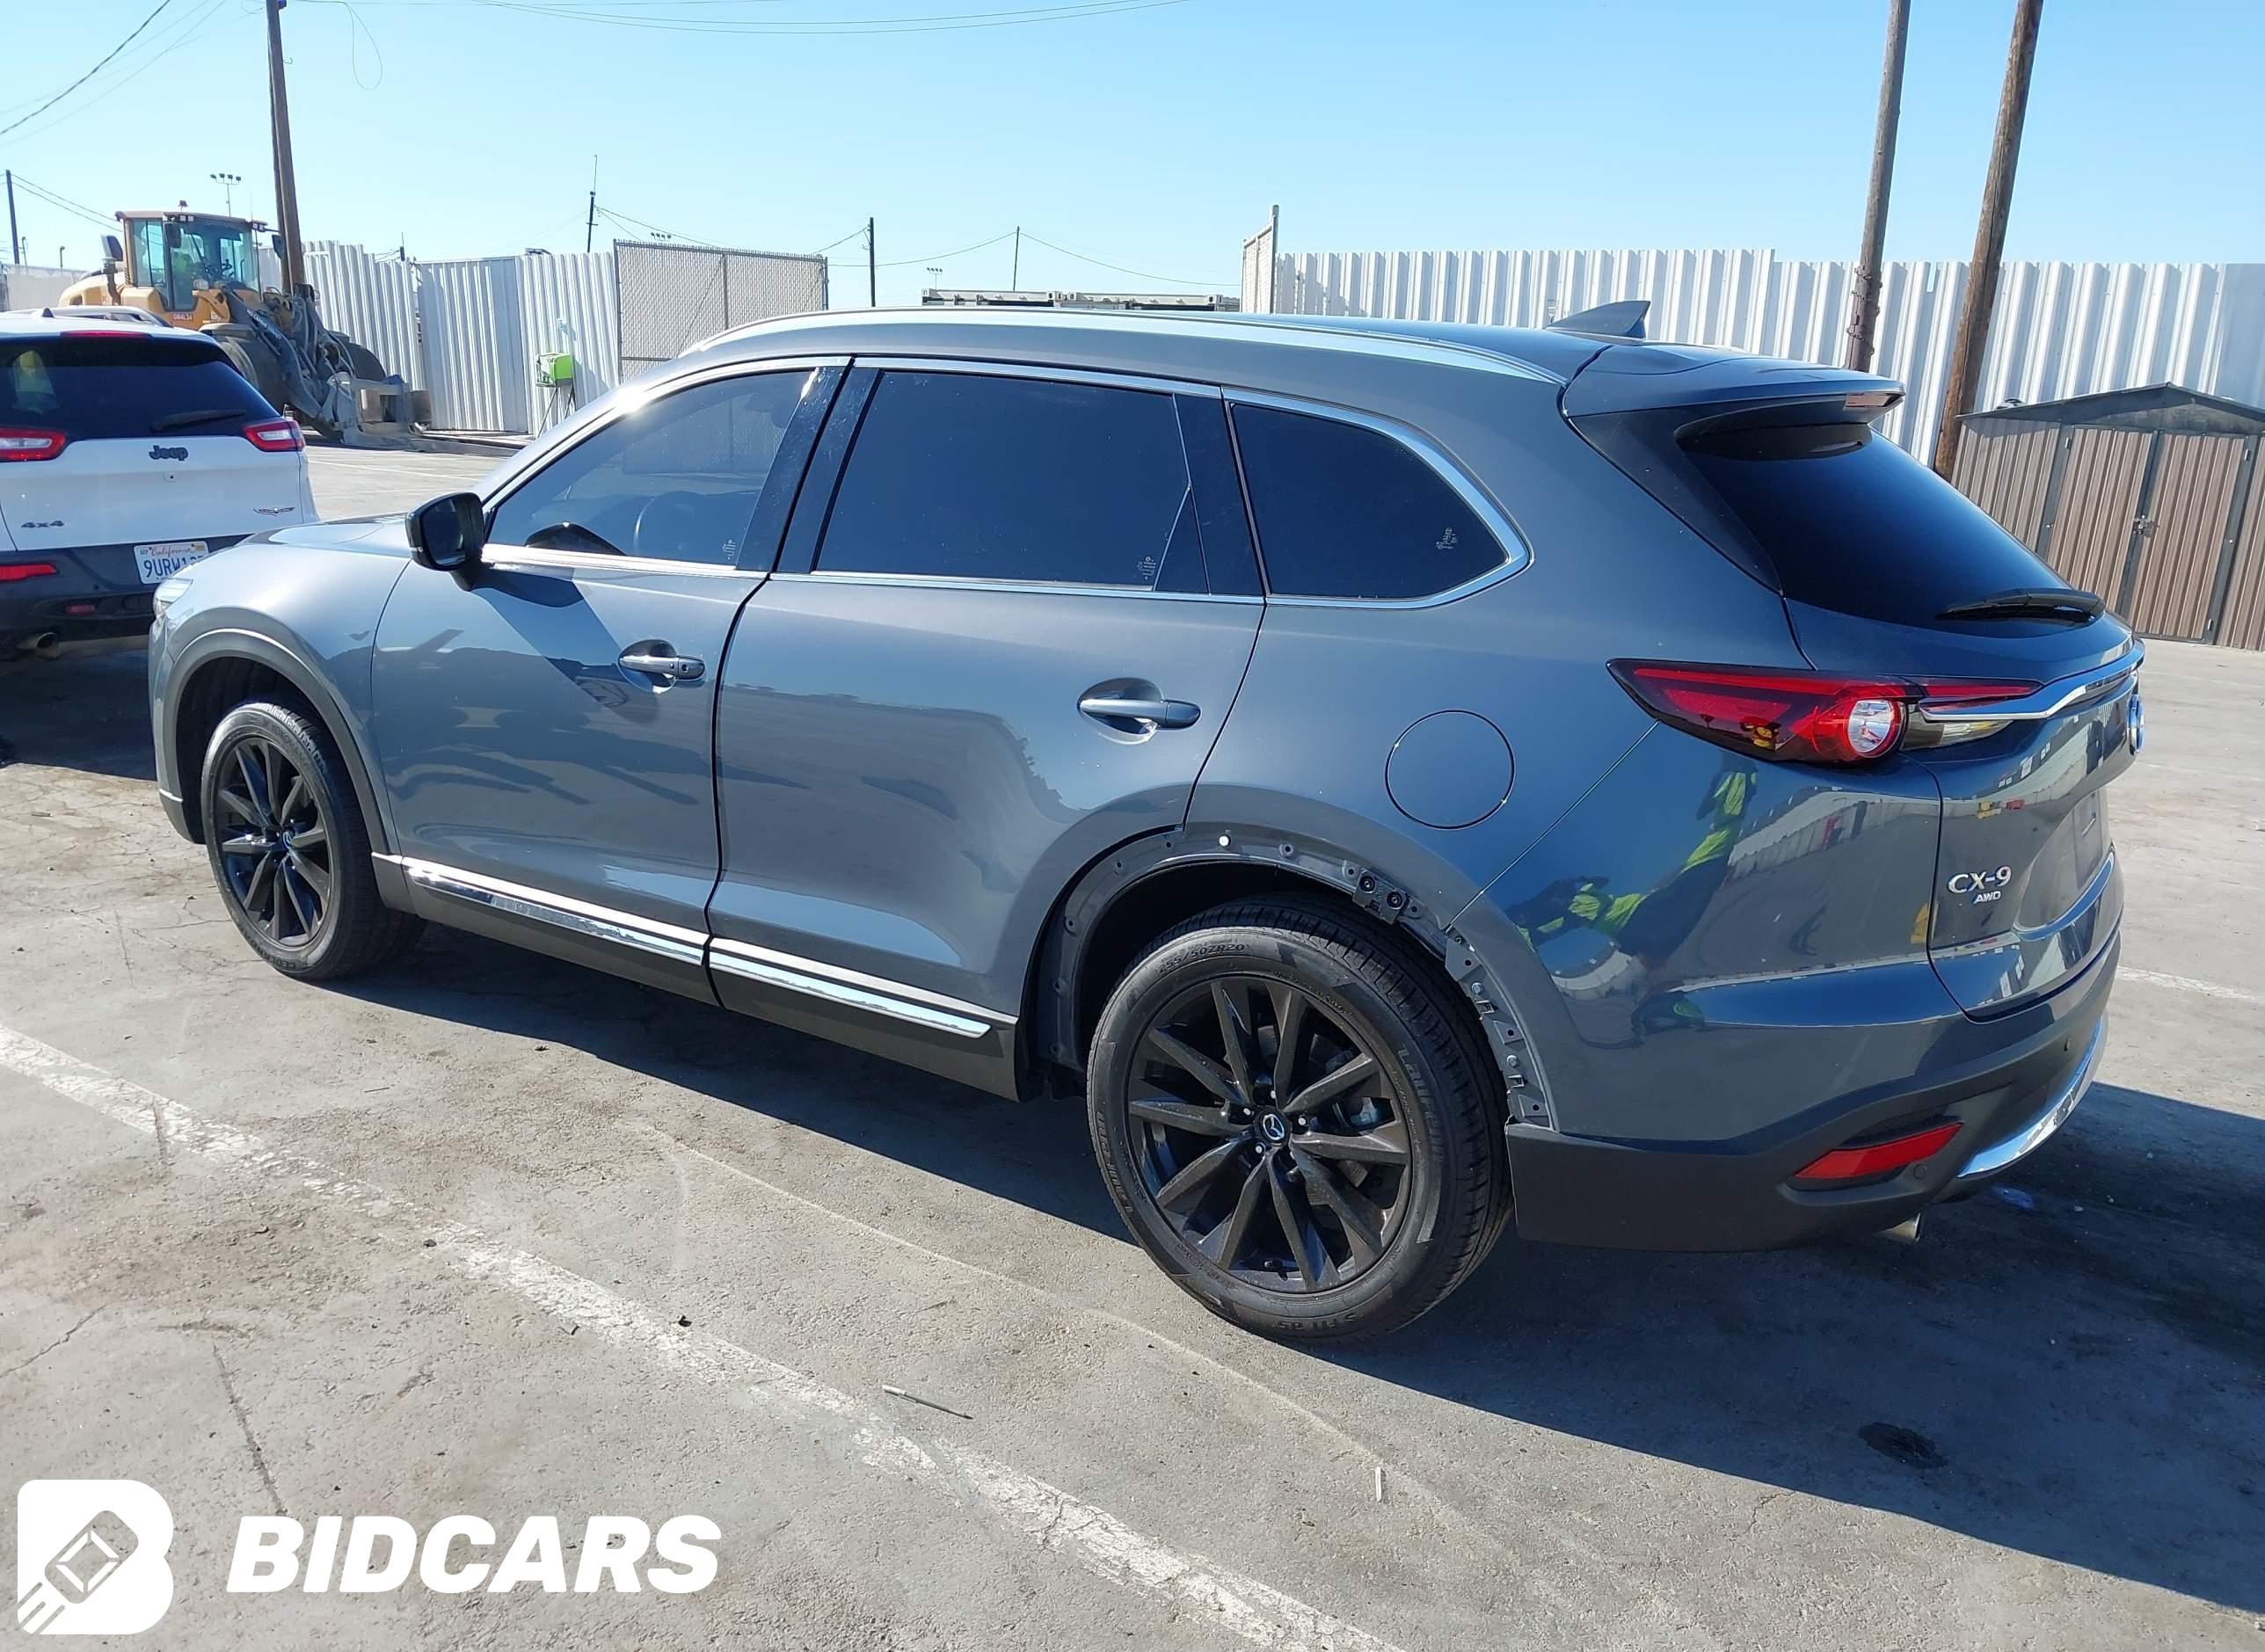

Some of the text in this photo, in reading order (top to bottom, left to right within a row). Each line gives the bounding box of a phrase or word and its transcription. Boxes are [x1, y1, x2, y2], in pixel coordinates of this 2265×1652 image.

[149, 445, 188, 461] Jeep
[21, 520, 64, 528] 4x4
[143, 555, 204, 578] 9URW1
[1948, 865, 2013, 894] CX-9
[1973, 890, 2002, 905] AWD
[1159, 942, 1247, 973] 255/50ZR20
